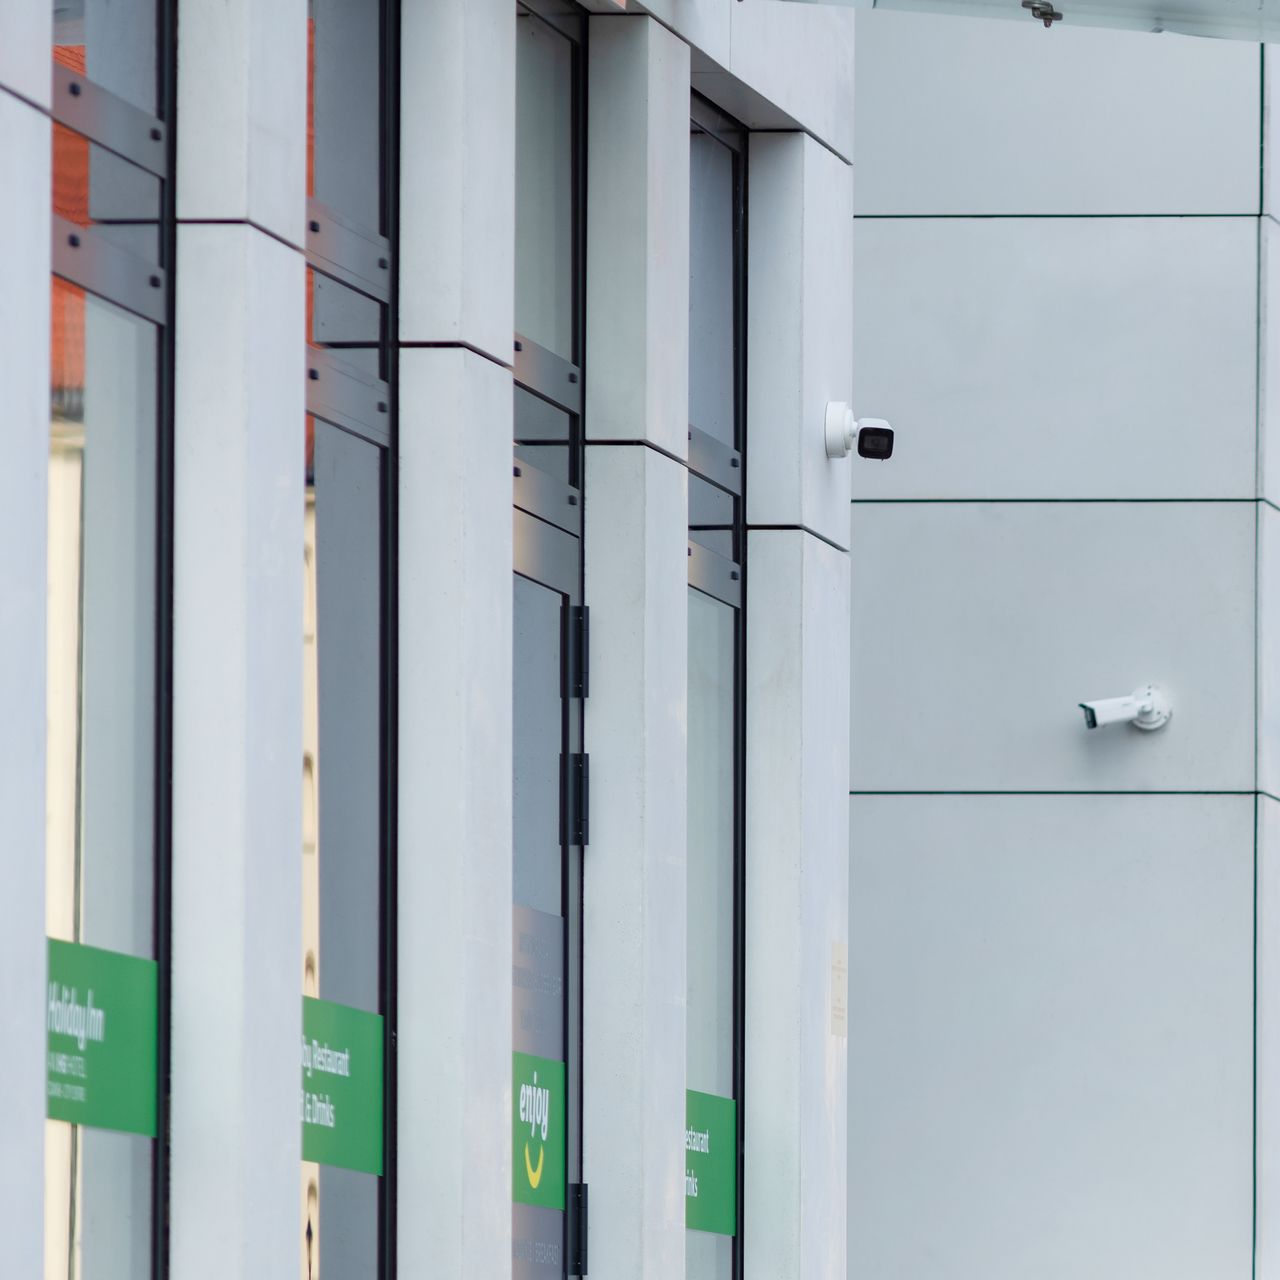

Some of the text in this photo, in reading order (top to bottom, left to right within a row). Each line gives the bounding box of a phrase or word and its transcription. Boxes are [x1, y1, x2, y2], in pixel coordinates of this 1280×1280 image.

[312, 1040, 350, 1076] Restaurant
[312, 1093, 335, 1127] Drinks
[519, 1071, 549, 1141] enjoy
